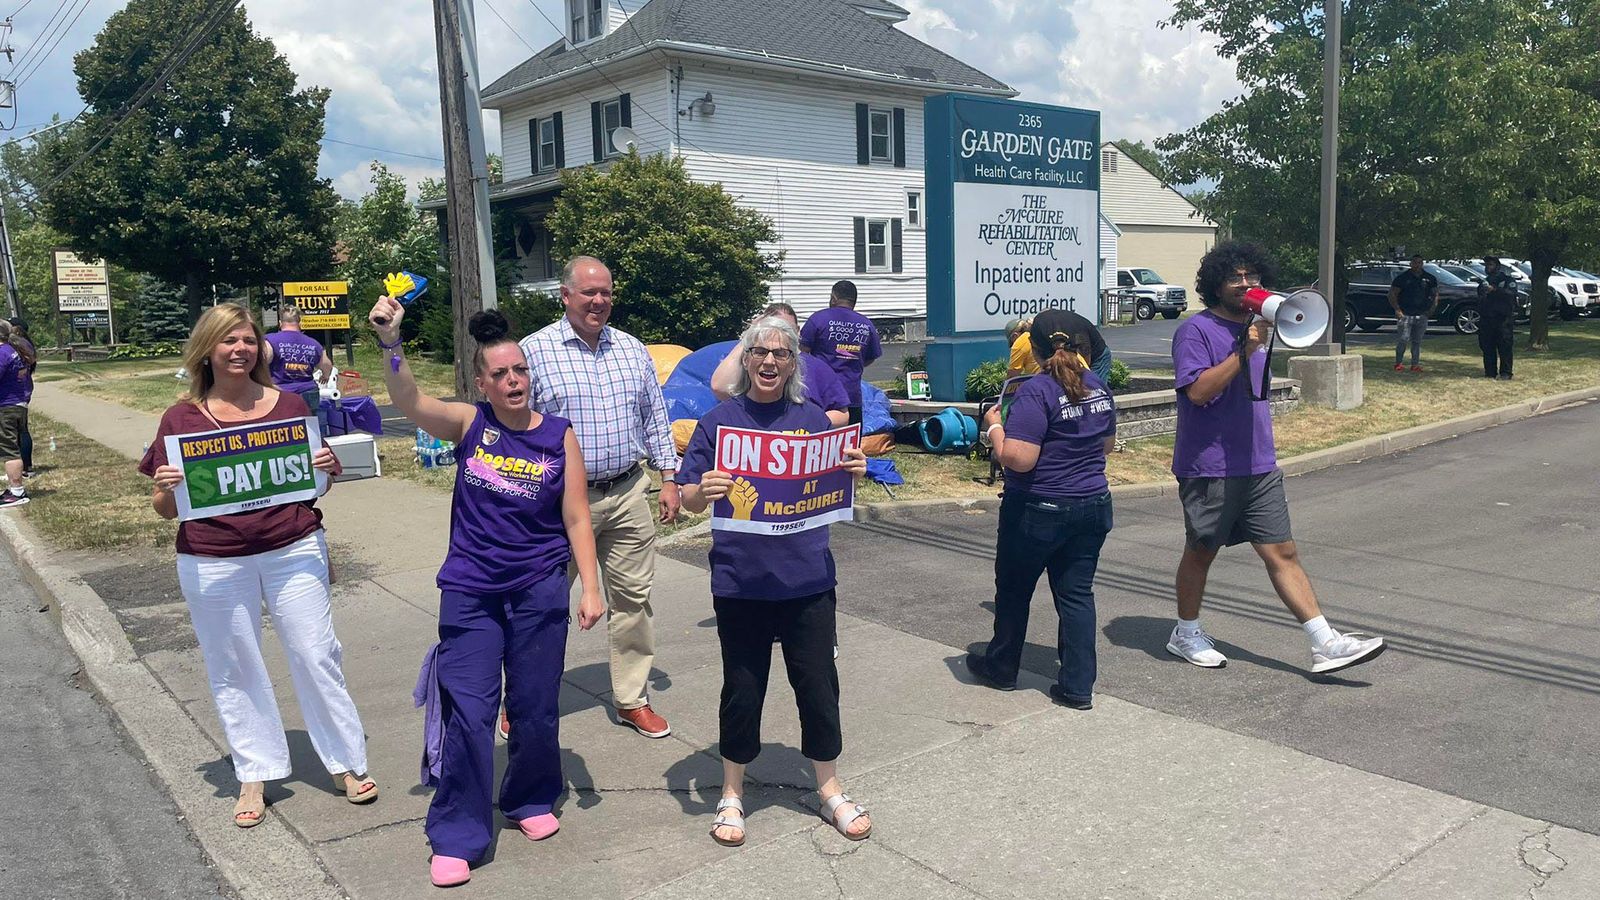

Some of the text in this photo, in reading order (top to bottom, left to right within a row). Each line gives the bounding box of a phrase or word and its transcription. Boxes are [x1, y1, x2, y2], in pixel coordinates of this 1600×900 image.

[1018, 113, 1042, 128] 2365
[961, 129, 1093, 165] GARDEN GATE
[975, 163, 1084, 185] Health Care Facility, LLC
[1022, 194, 1047, 209] THE
[998, 209, 1064, 225] McGUIRE
[978, 224, 1081, 245] REHABILITATION
[1006, 240, 1057, 261] CENTER
[975, 260, 1084, 291] Inpatient and
[294, 296, 338, 310] HUNT
[984, 292, 1076, 319] Outpatient
[828, 320, 854, 328] QUALITY
[828, 332, 868, 346] FOR ALL
[280, 352, 298, 362] FOR
[182, 424, 306, 458] RESPECT US, PROTECT US
[722, 433, 762, 472] ON
[217, 460, 262, 495] PAY
[268, 452, 311, 486] US!
[464, 468, 496, 483] QUALITY
[521, 482, 541, 492] AND
[530, 474, 542, 482] East
[482, 480, 503, 494] JOBS
[504, 486, 522, 497] FOR
[522, 490, 537, 500] ALL
[802, 479, 818, 495] AT
[764, 490, 844, 516] McGUIRE!
[770, 520, 806, 532] 1199SEIU
